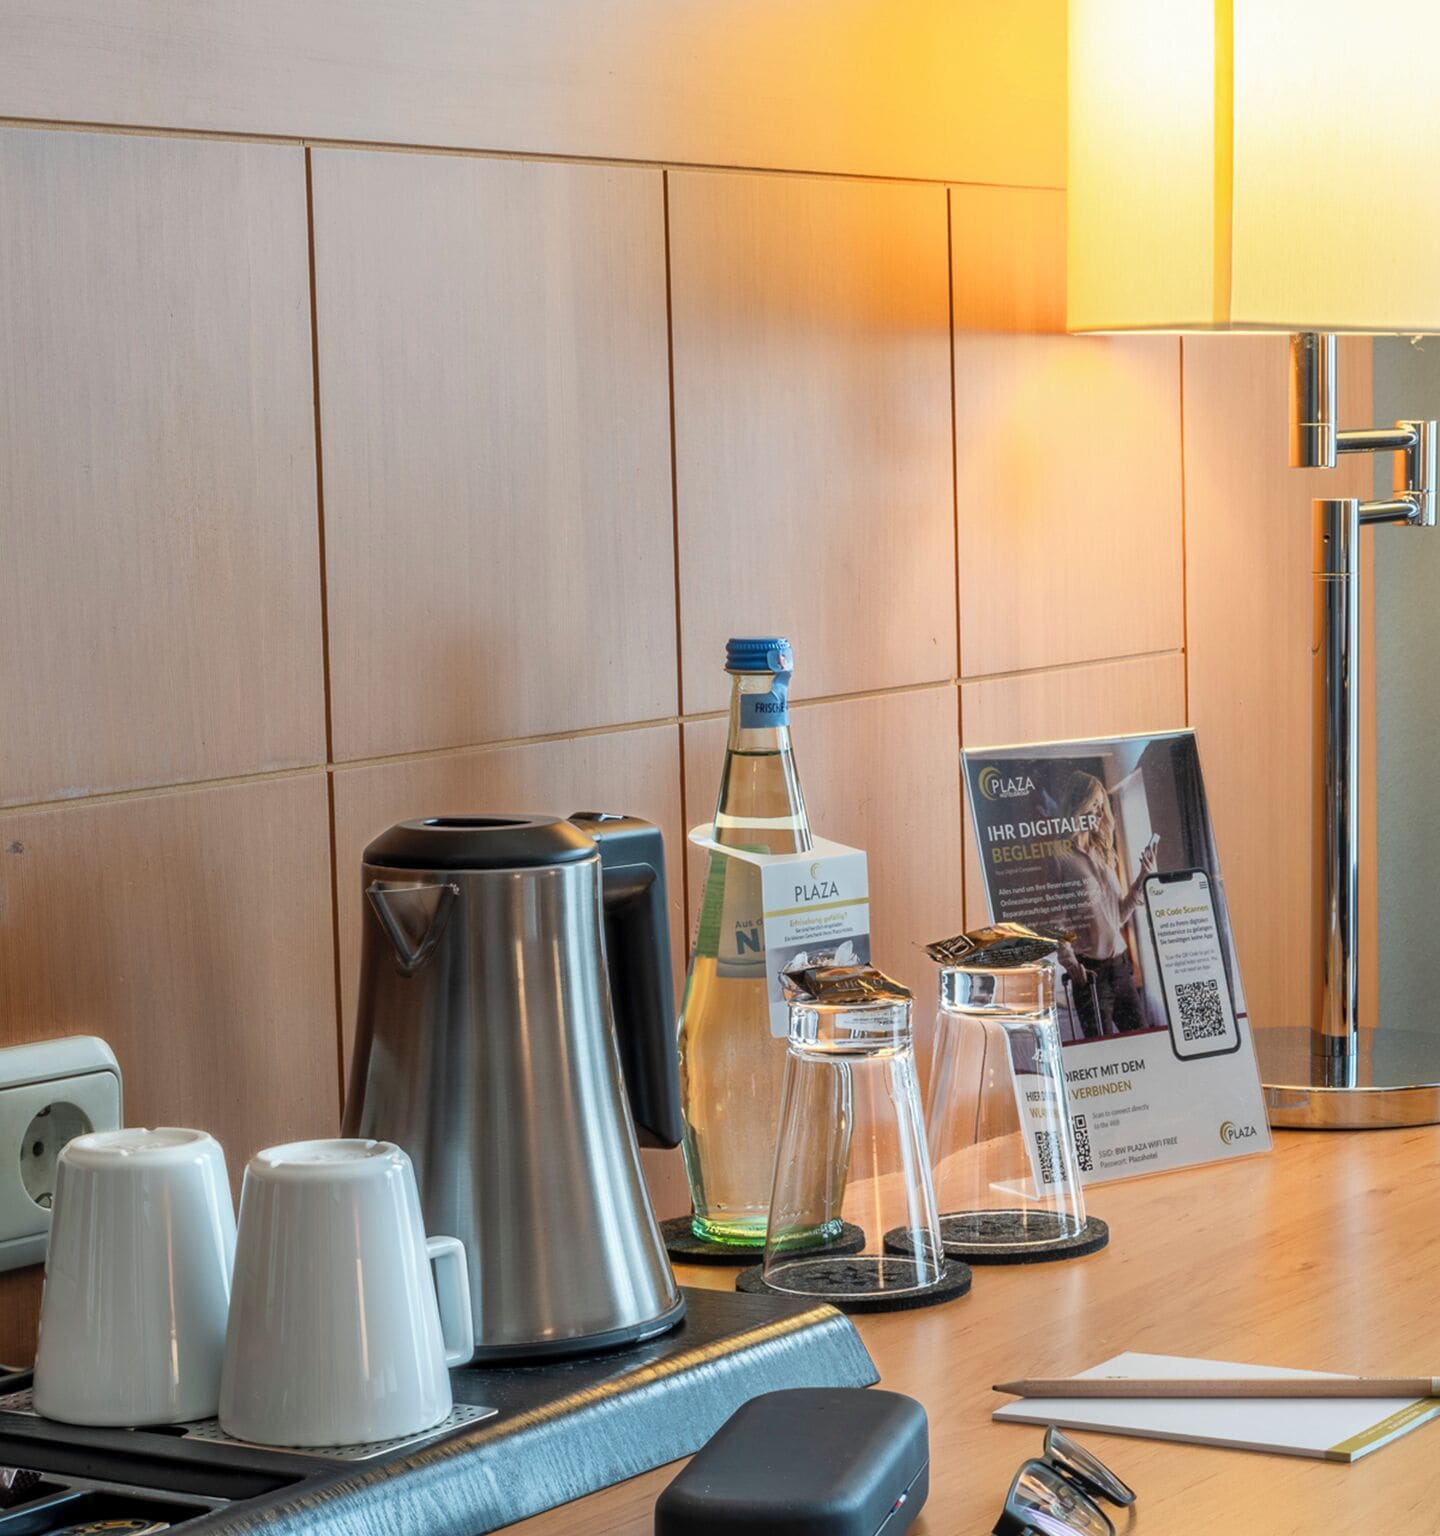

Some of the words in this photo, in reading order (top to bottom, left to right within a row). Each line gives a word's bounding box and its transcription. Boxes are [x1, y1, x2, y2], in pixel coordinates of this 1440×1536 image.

[991, 777, 1036, 794] PLAZA
[987, 824, 1016, 842] IHR
[1019, 814, 1099, 838] DIGITALER
[992, 839, 1073, 864] BEGLEITER
[794, 881, 839, 902] PLAZA
[1154, 909, 1165, 918] QR
[1166, 907, 1182, 917] Code
[735, 919, 753, 928] Aus
[736, 928, 765, 955] N
[1100, 1063, 1119, 1077] MIT
[1122, 1059, 1146, 1074] DEM
[1071, 1079, 1133, 1100] VERBINDEN
[1228, 1124, 1257, 1140] PLAZA
[1127, 1142, 1147, 1153] PLAZA
[1163, 1136, 1178, 1147] FREE
